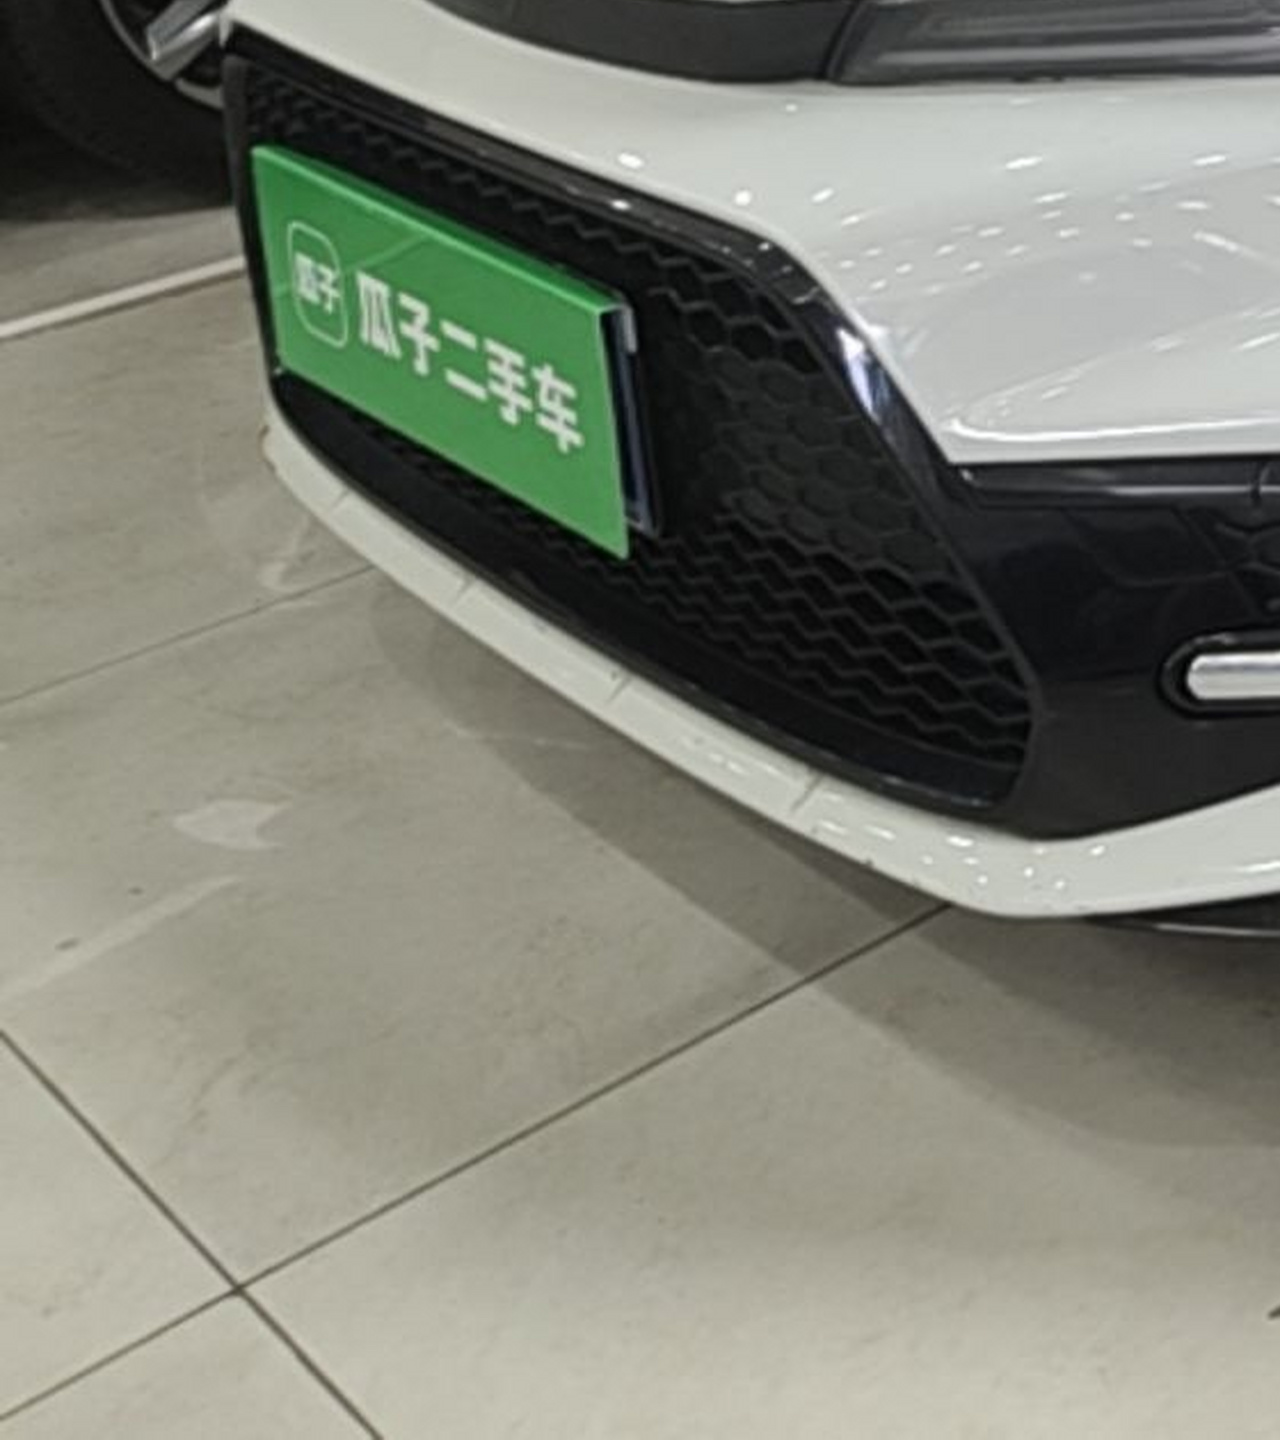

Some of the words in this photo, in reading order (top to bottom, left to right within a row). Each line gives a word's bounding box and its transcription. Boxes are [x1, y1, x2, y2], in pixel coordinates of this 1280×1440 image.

[356, 271, 583, 453] 瓜子二手车
